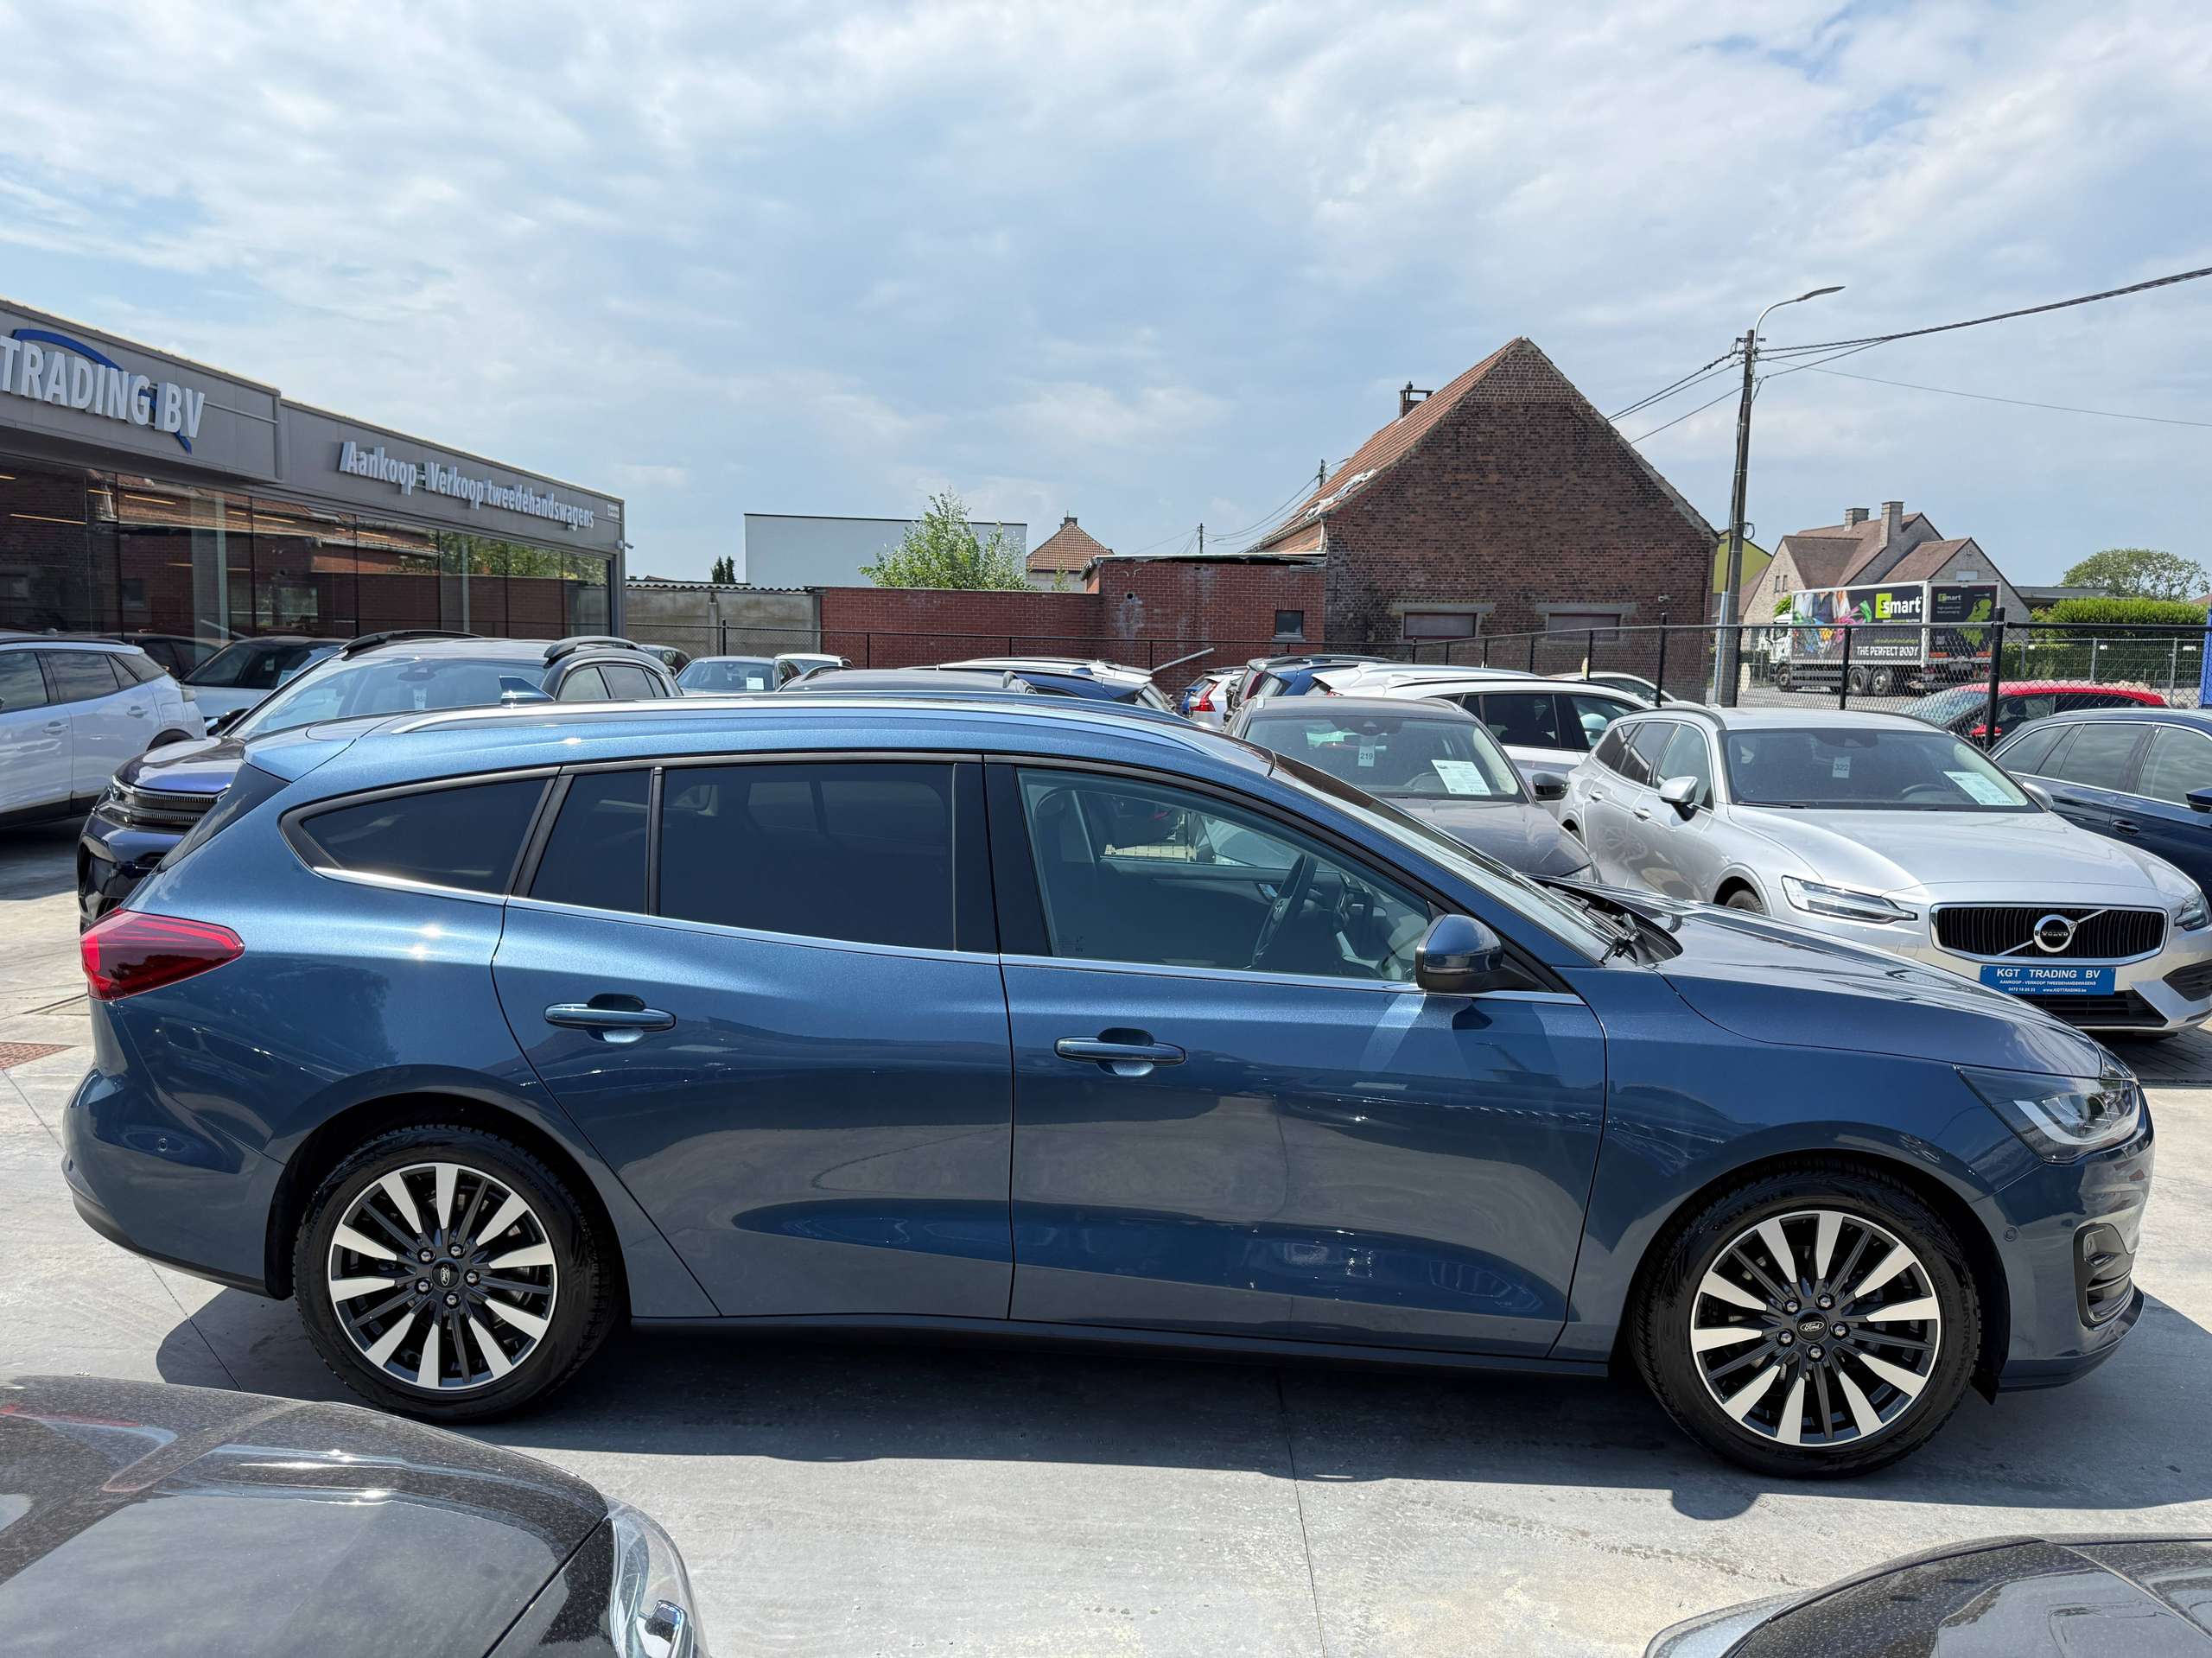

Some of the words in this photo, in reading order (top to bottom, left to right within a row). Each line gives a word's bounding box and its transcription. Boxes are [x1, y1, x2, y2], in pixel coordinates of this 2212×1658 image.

[0, 335, 150, 425] TRADING
[159, 382, 205, 438] BV
[340, 441, 416, 495] Aankoop
[427, 462, 483, 509] Verkoop
[487, 480, 594, 530] tweedehandswagens
[1857, 646, 1869, 656] THE
[1870, 646, 1898, 656] PERFECT
[1899, 646, 1918, 657] BODY
[1997, 969, 2020, 978] KGT
[2029, 969, 2077, 979] TRADING
[2086, 969, 2101, 979] BV
